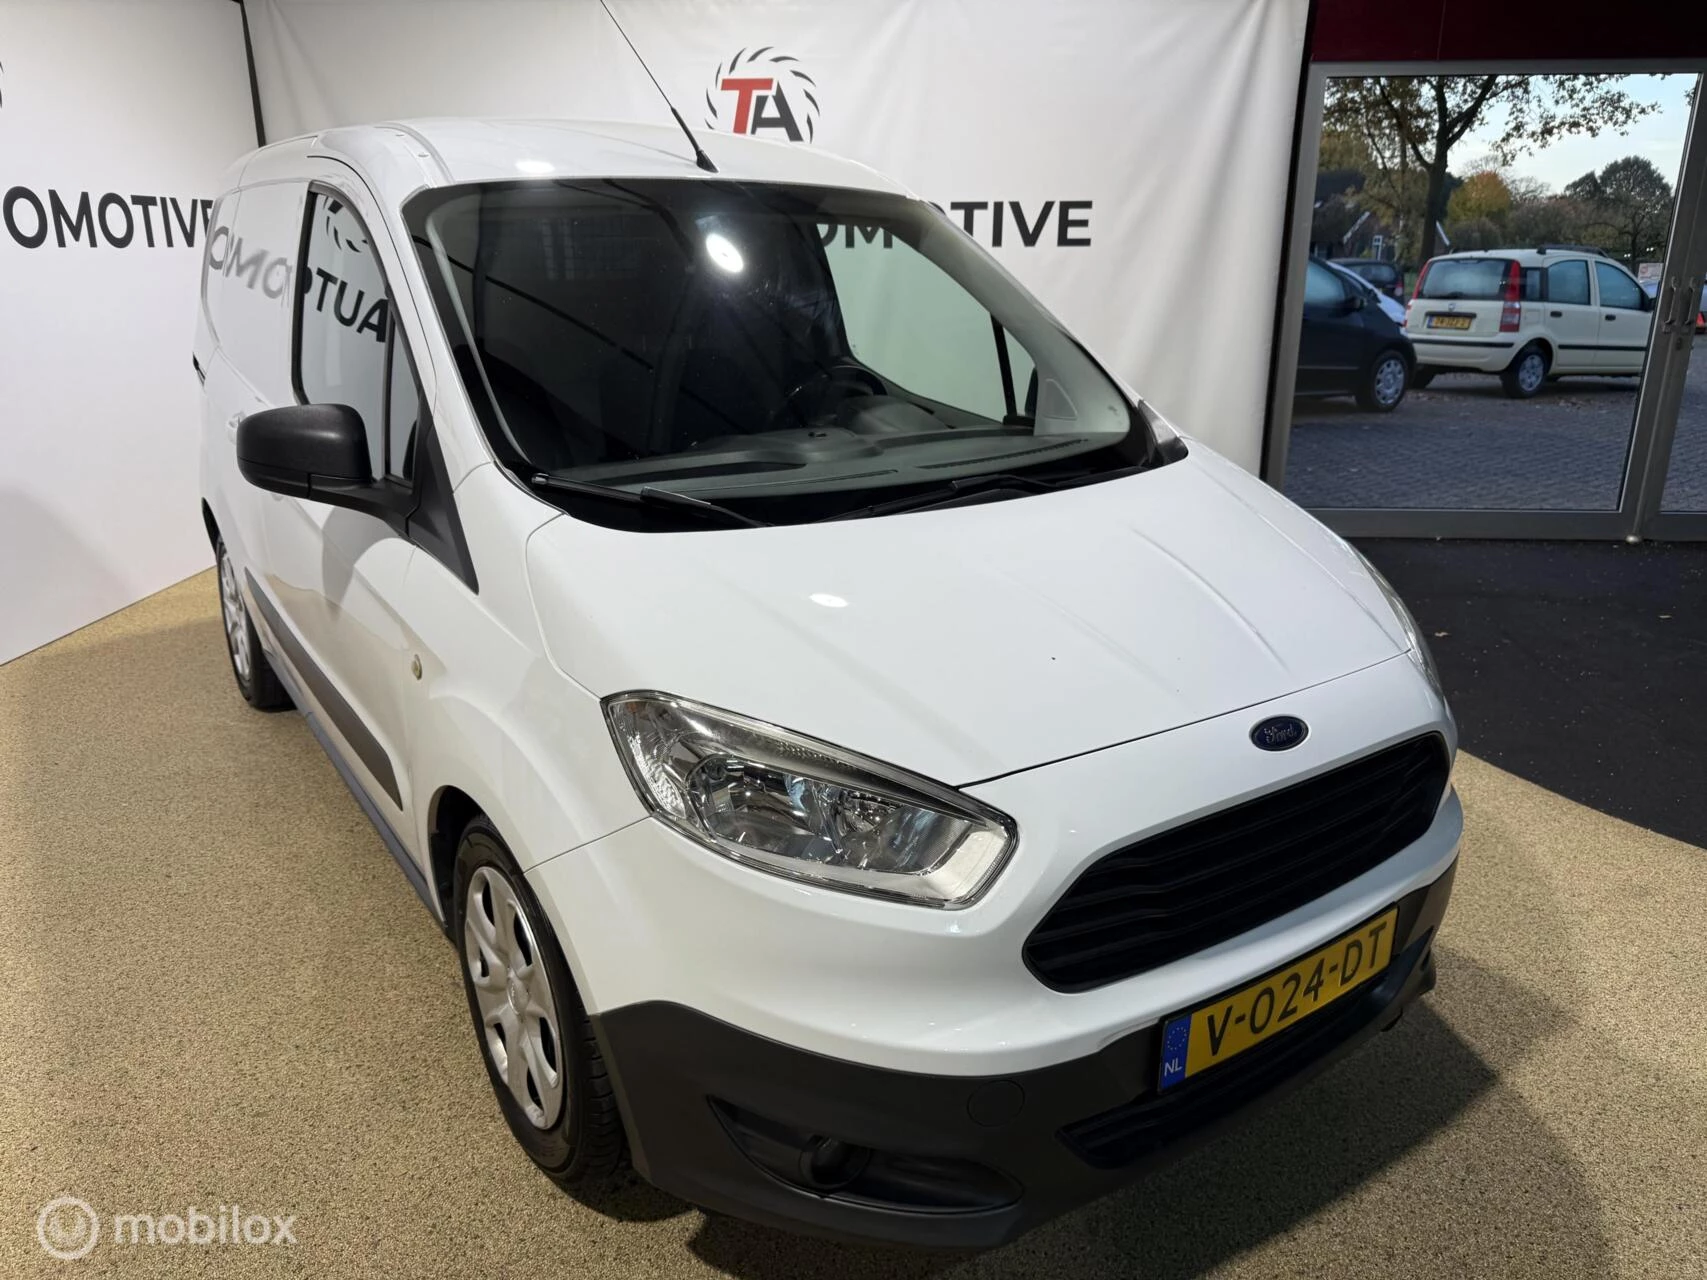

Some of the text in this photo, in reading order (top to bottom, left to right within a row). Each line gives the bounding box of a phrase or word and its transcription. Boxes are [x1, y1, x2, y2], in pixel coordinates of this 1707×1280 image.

[720, 77, 803, 142] TA
[1206, 921, 1388, 1057] V-024-DT
[1164, 1058, 1183, 1077] NL
